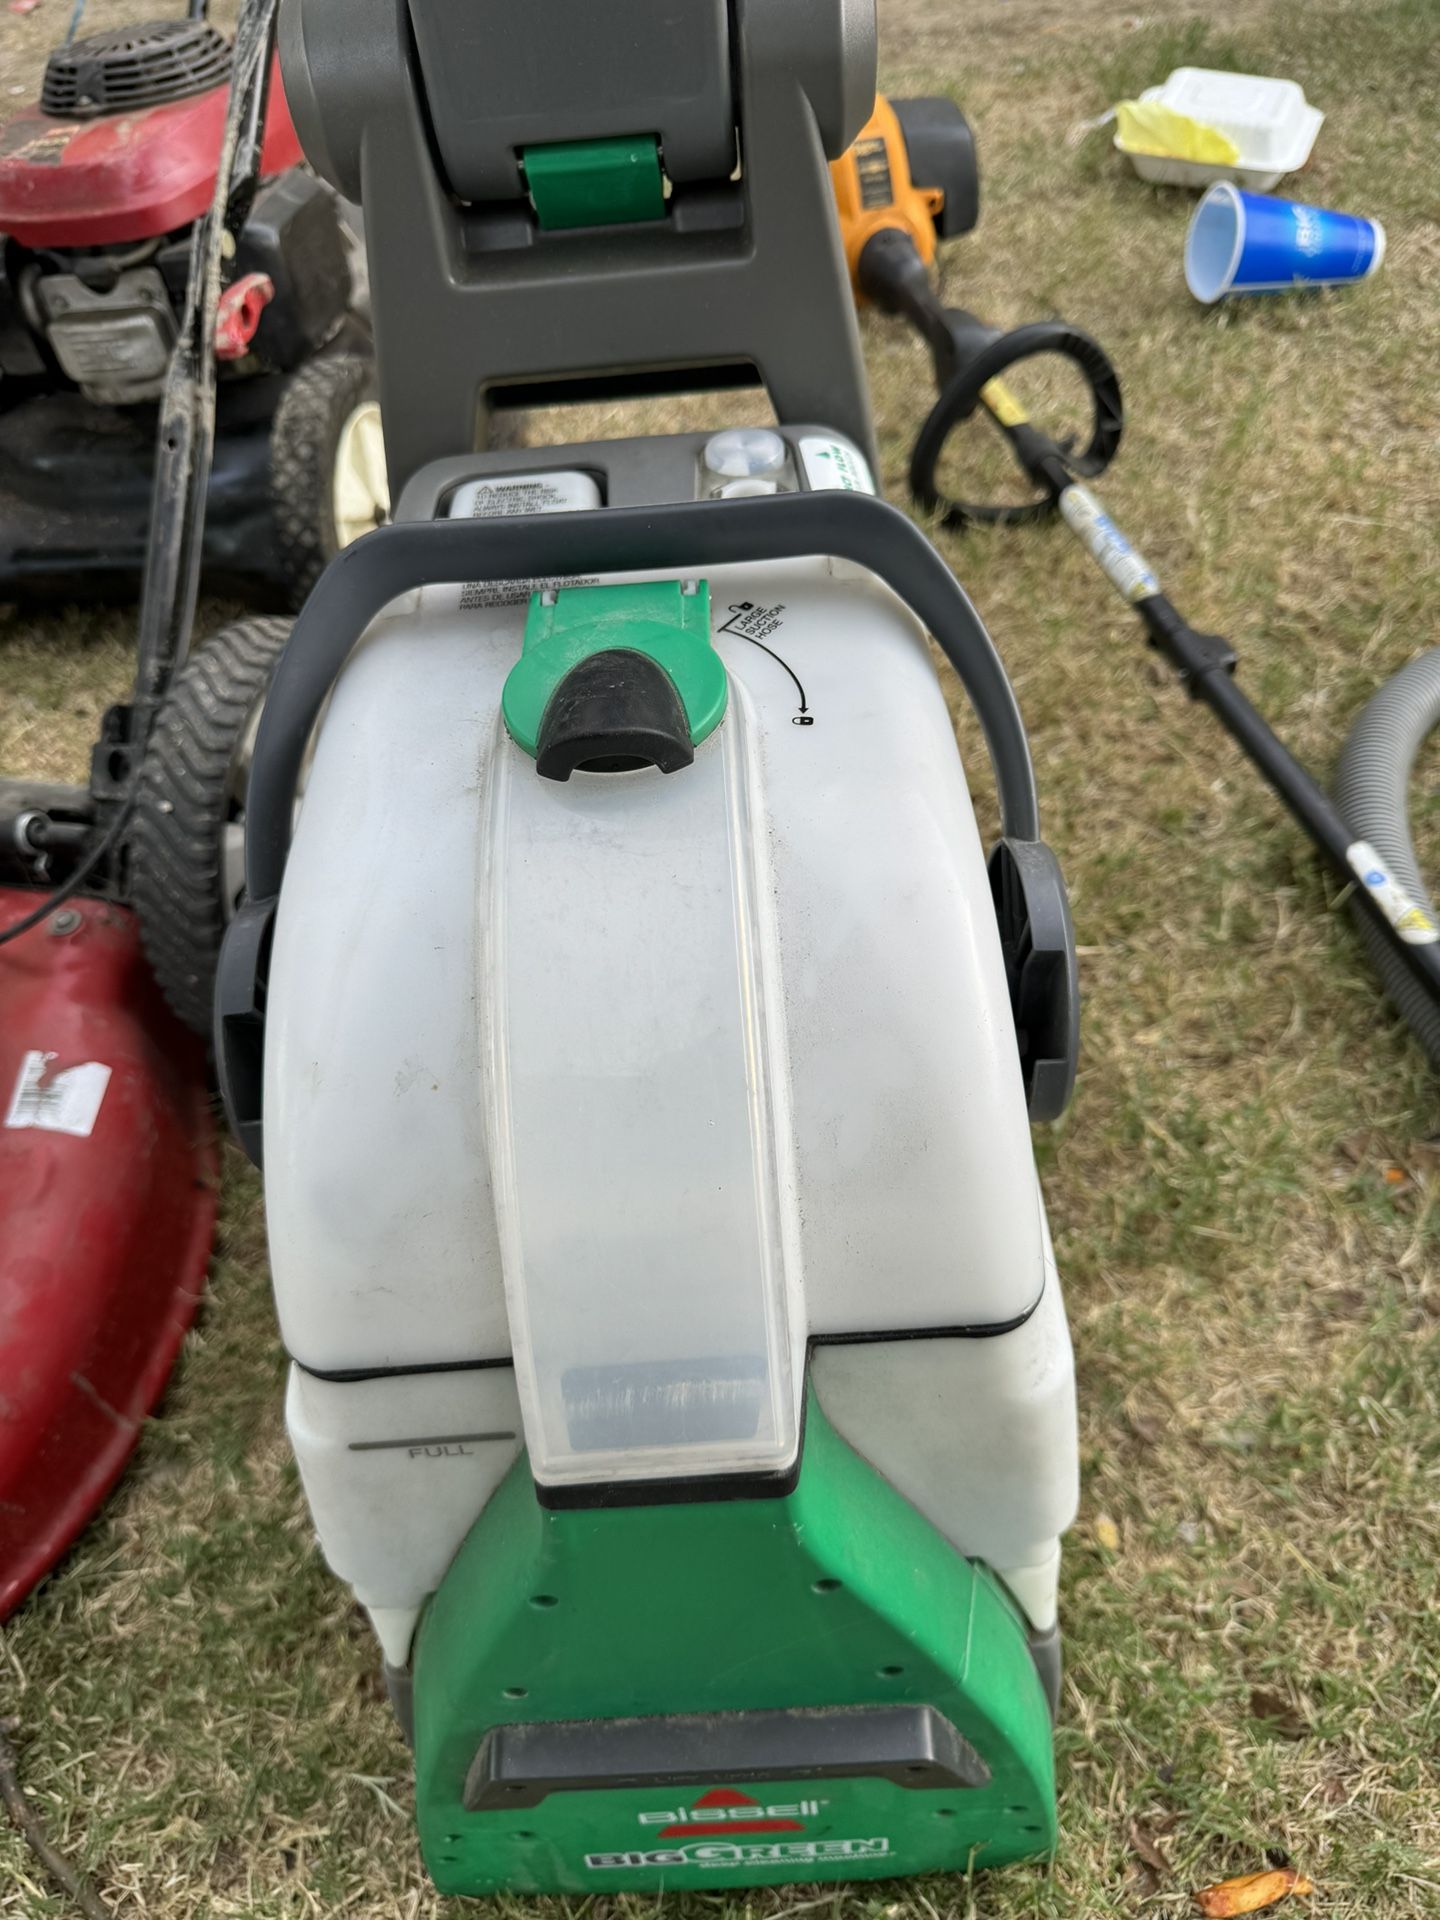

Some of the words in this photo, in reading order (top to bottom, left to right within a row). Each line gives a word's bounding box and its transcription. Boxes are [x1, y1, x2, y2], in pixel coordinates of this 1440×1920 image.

[496, 483, 541, 492] WARNING
[461, 587, 499, 597] SIEMPRE
[553, 578, 600, 590] FLOTADOR
[459, 601, 483, 610] PARA
[484, 598, 529, 609] RECOGER
[460, 593, 490, 603] ANTES
[491, 592, 505, 600] DE
[506, 590, 531, 600] USAR
[734, 606, 767, 630] LARGE
[745, 604, 786, 635] SUCTION
[755, 618, 783, 640] HOSE
[408, 1444, 475, 1459] FULL
